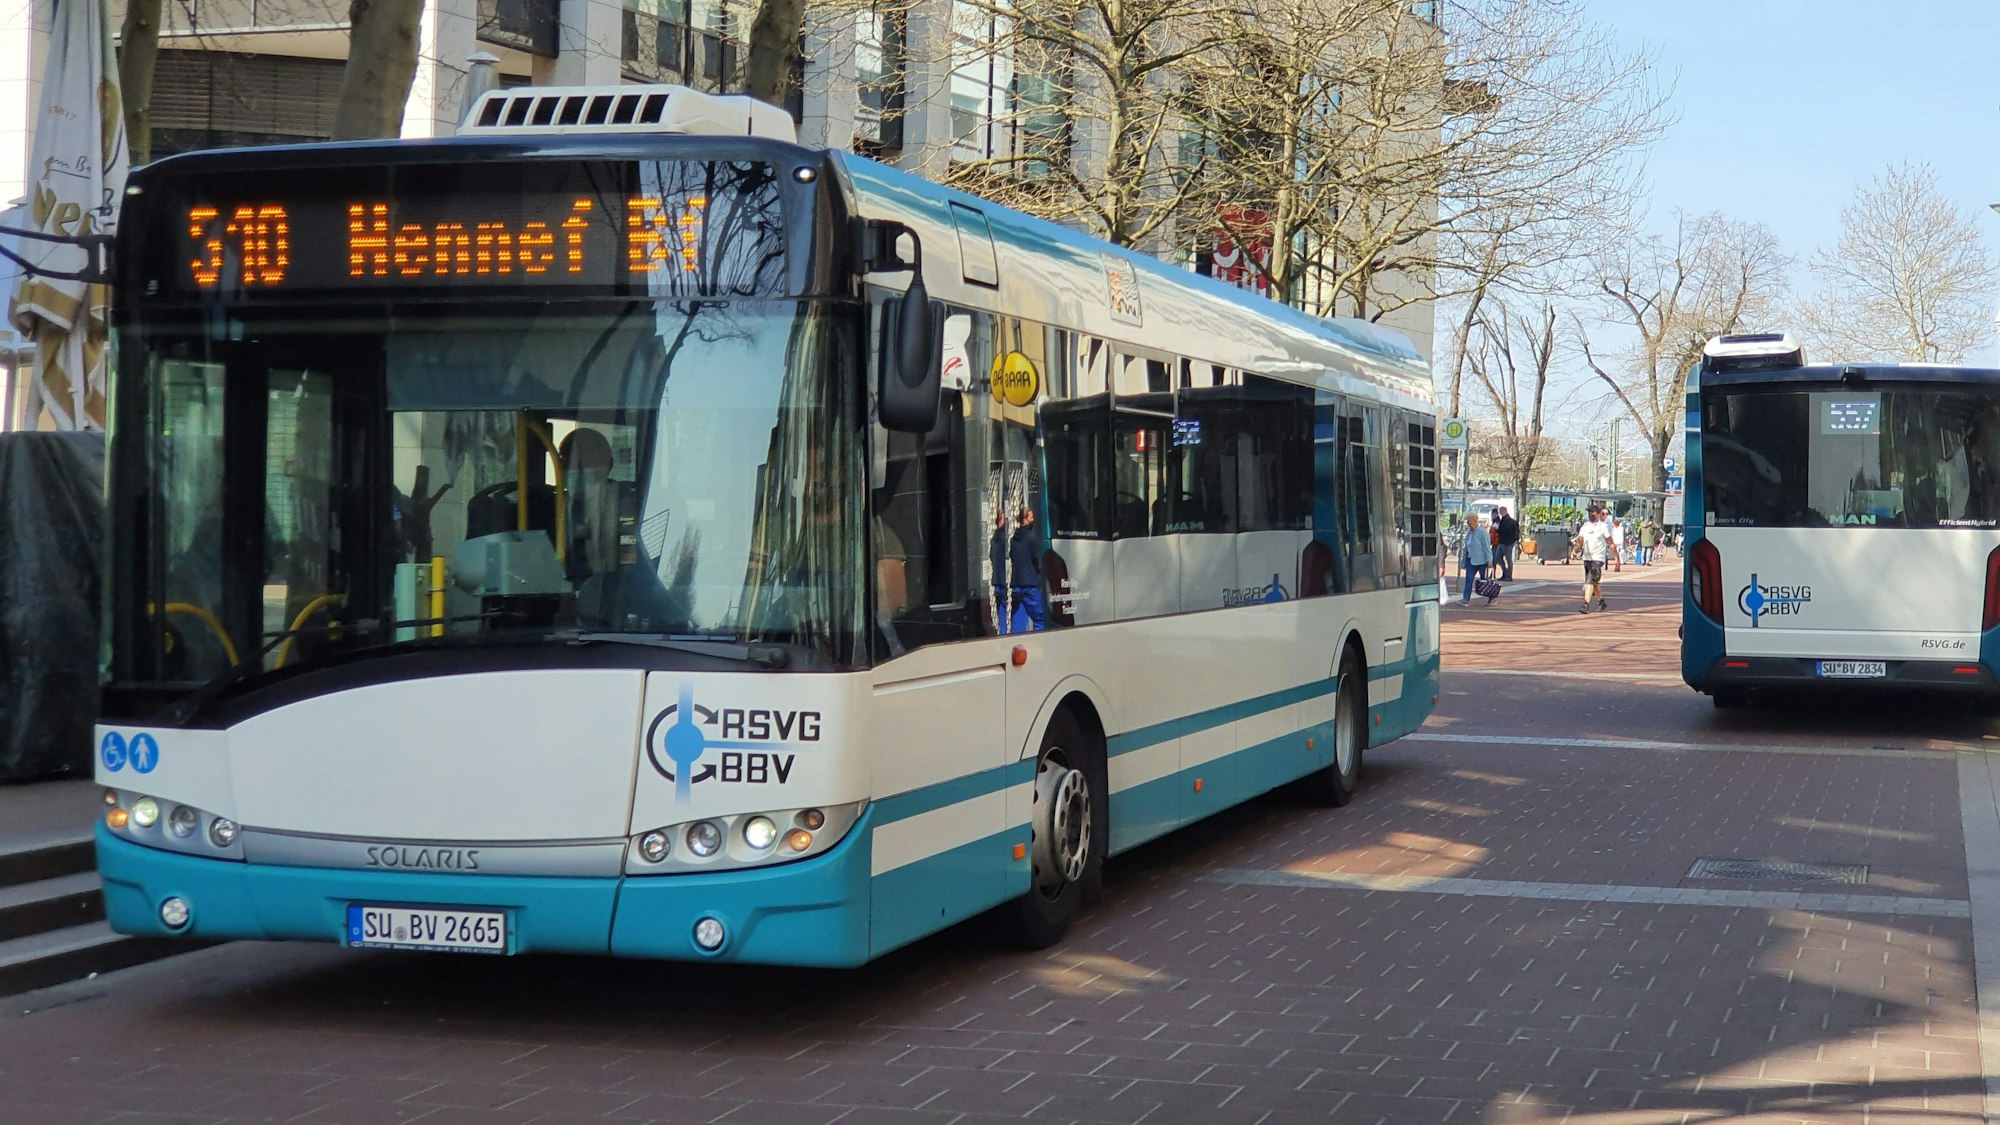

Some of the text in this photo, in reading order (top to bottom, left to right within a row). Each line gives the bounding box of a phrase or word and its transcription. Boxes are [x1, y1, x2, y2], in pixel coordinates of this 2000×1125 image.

[190, 197, 706, 283] 510 Hennef Bf
[1830, 403, 1876, 429] 557
[1829, 514, 1876, 525] MAN
[1939, 519, 1997, 527] EfficientHybrid
[1770, 586, 1811, 599] RSVG
[1770, 602, 1801, 615] BBV
[1921, 639, 1966, 650] RSVG.de
[1858, 663, 1884, 675] 2834
[722, 708, 821, 742] RSVG
[721, 752, 795, 784] BBV
[366, 846, 480, 870] SOLARIS
[364, 911, 500, 944] SU BV 2665
